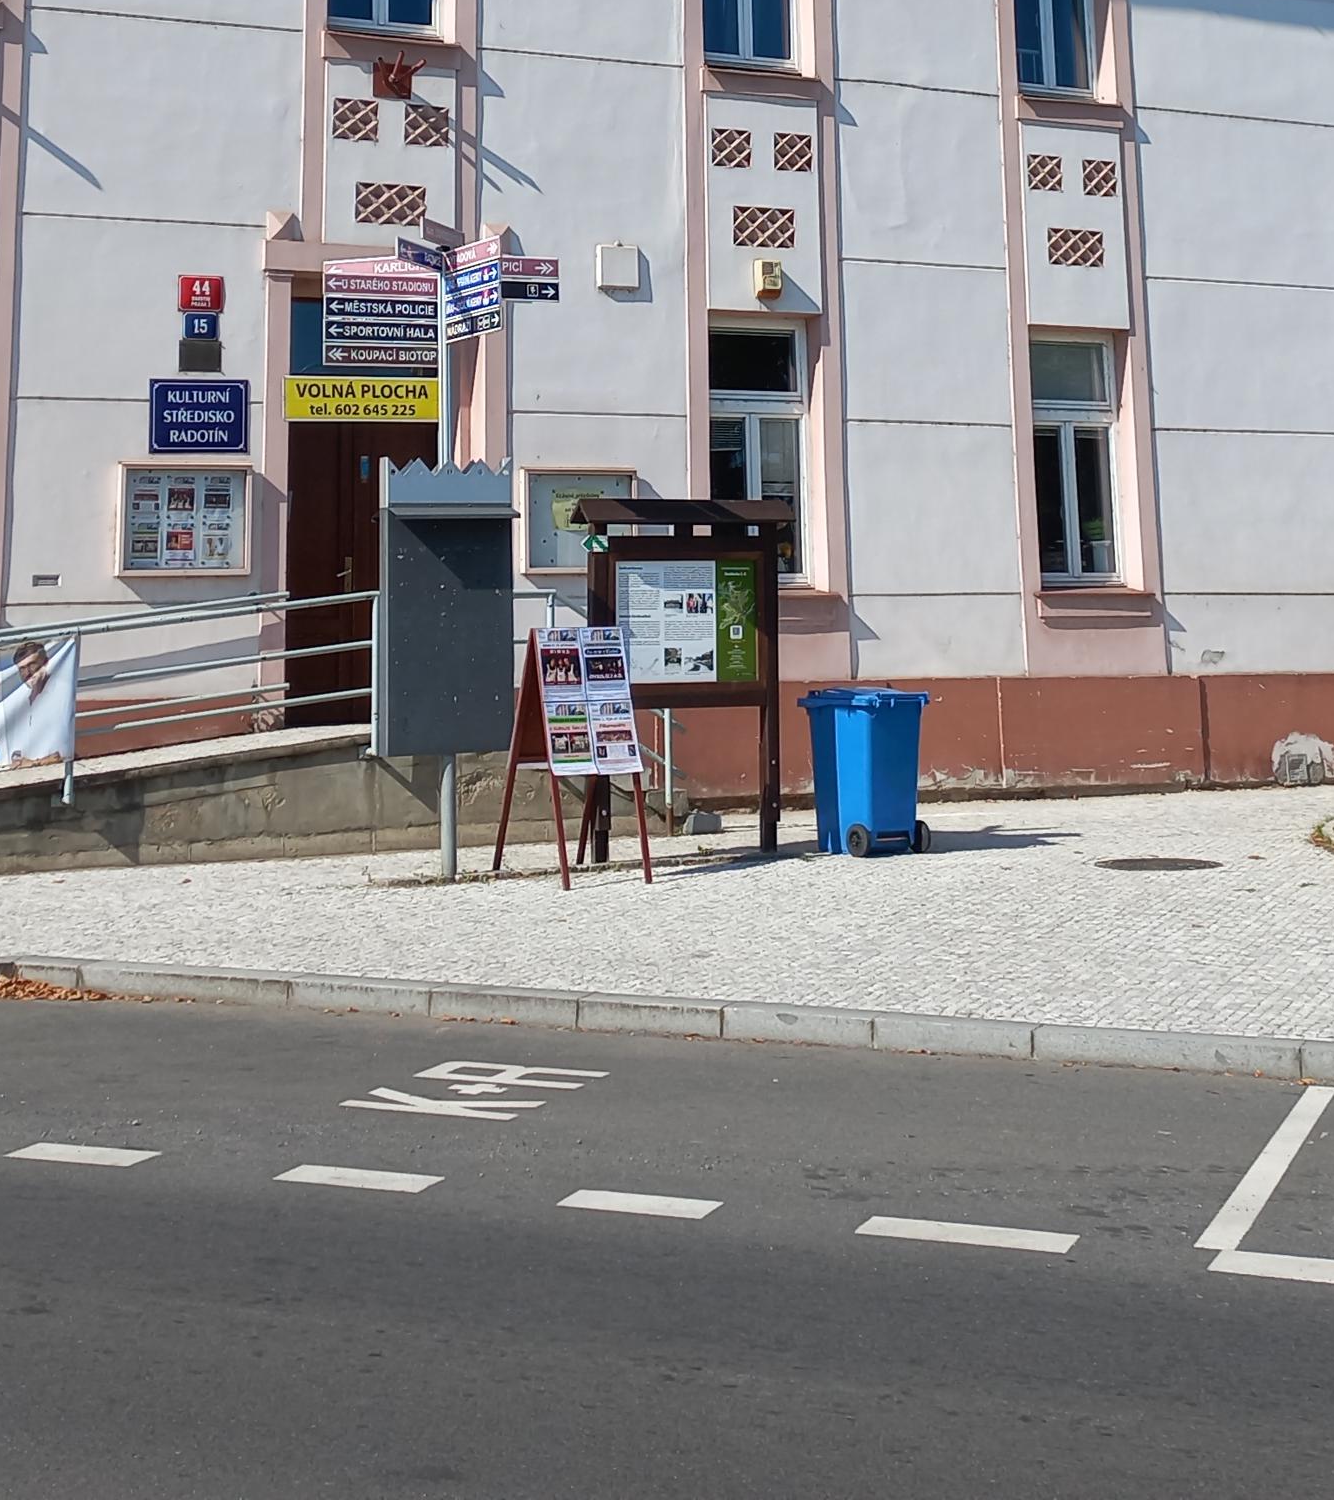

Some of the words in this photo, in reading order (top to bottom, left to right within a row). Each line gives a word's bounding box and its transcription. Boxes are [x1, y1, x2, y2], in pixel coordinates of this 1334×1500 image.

[192, 280, 210, 295] 44
[342, 279, 348, 289] U
[349, 277, 390, 291] STARÉHO
[391, 280, 434, 292] STADIONU
[345, 297, 393, 314] MĚSTSKÁ
[395, 302, 435, 315] POLICIE
[193, 319, 208, 334] 15
[343, 324, 403, 338] SPORTOVNÍ
[406, 326, 435, 338] HALA
[350, 348, 396, 360] KOUPACÍ
[399, 350, 437, 361] BIOTOP
[167, 388, 230, 403] KULTURNÍ
[296, 381, 356, 398] VOLNÁ
[361, 384, 428, 399] PLOCHA
[163, 406, 235, 423] STŘEDISKO
[309, 403, 331, 415] tel.
[335, 404, 360, 416] 602
[363, 404, 388, 416] 645
[392, 404, 416, 416] 225
[169, 427, 228, 442] RADOTÍN
